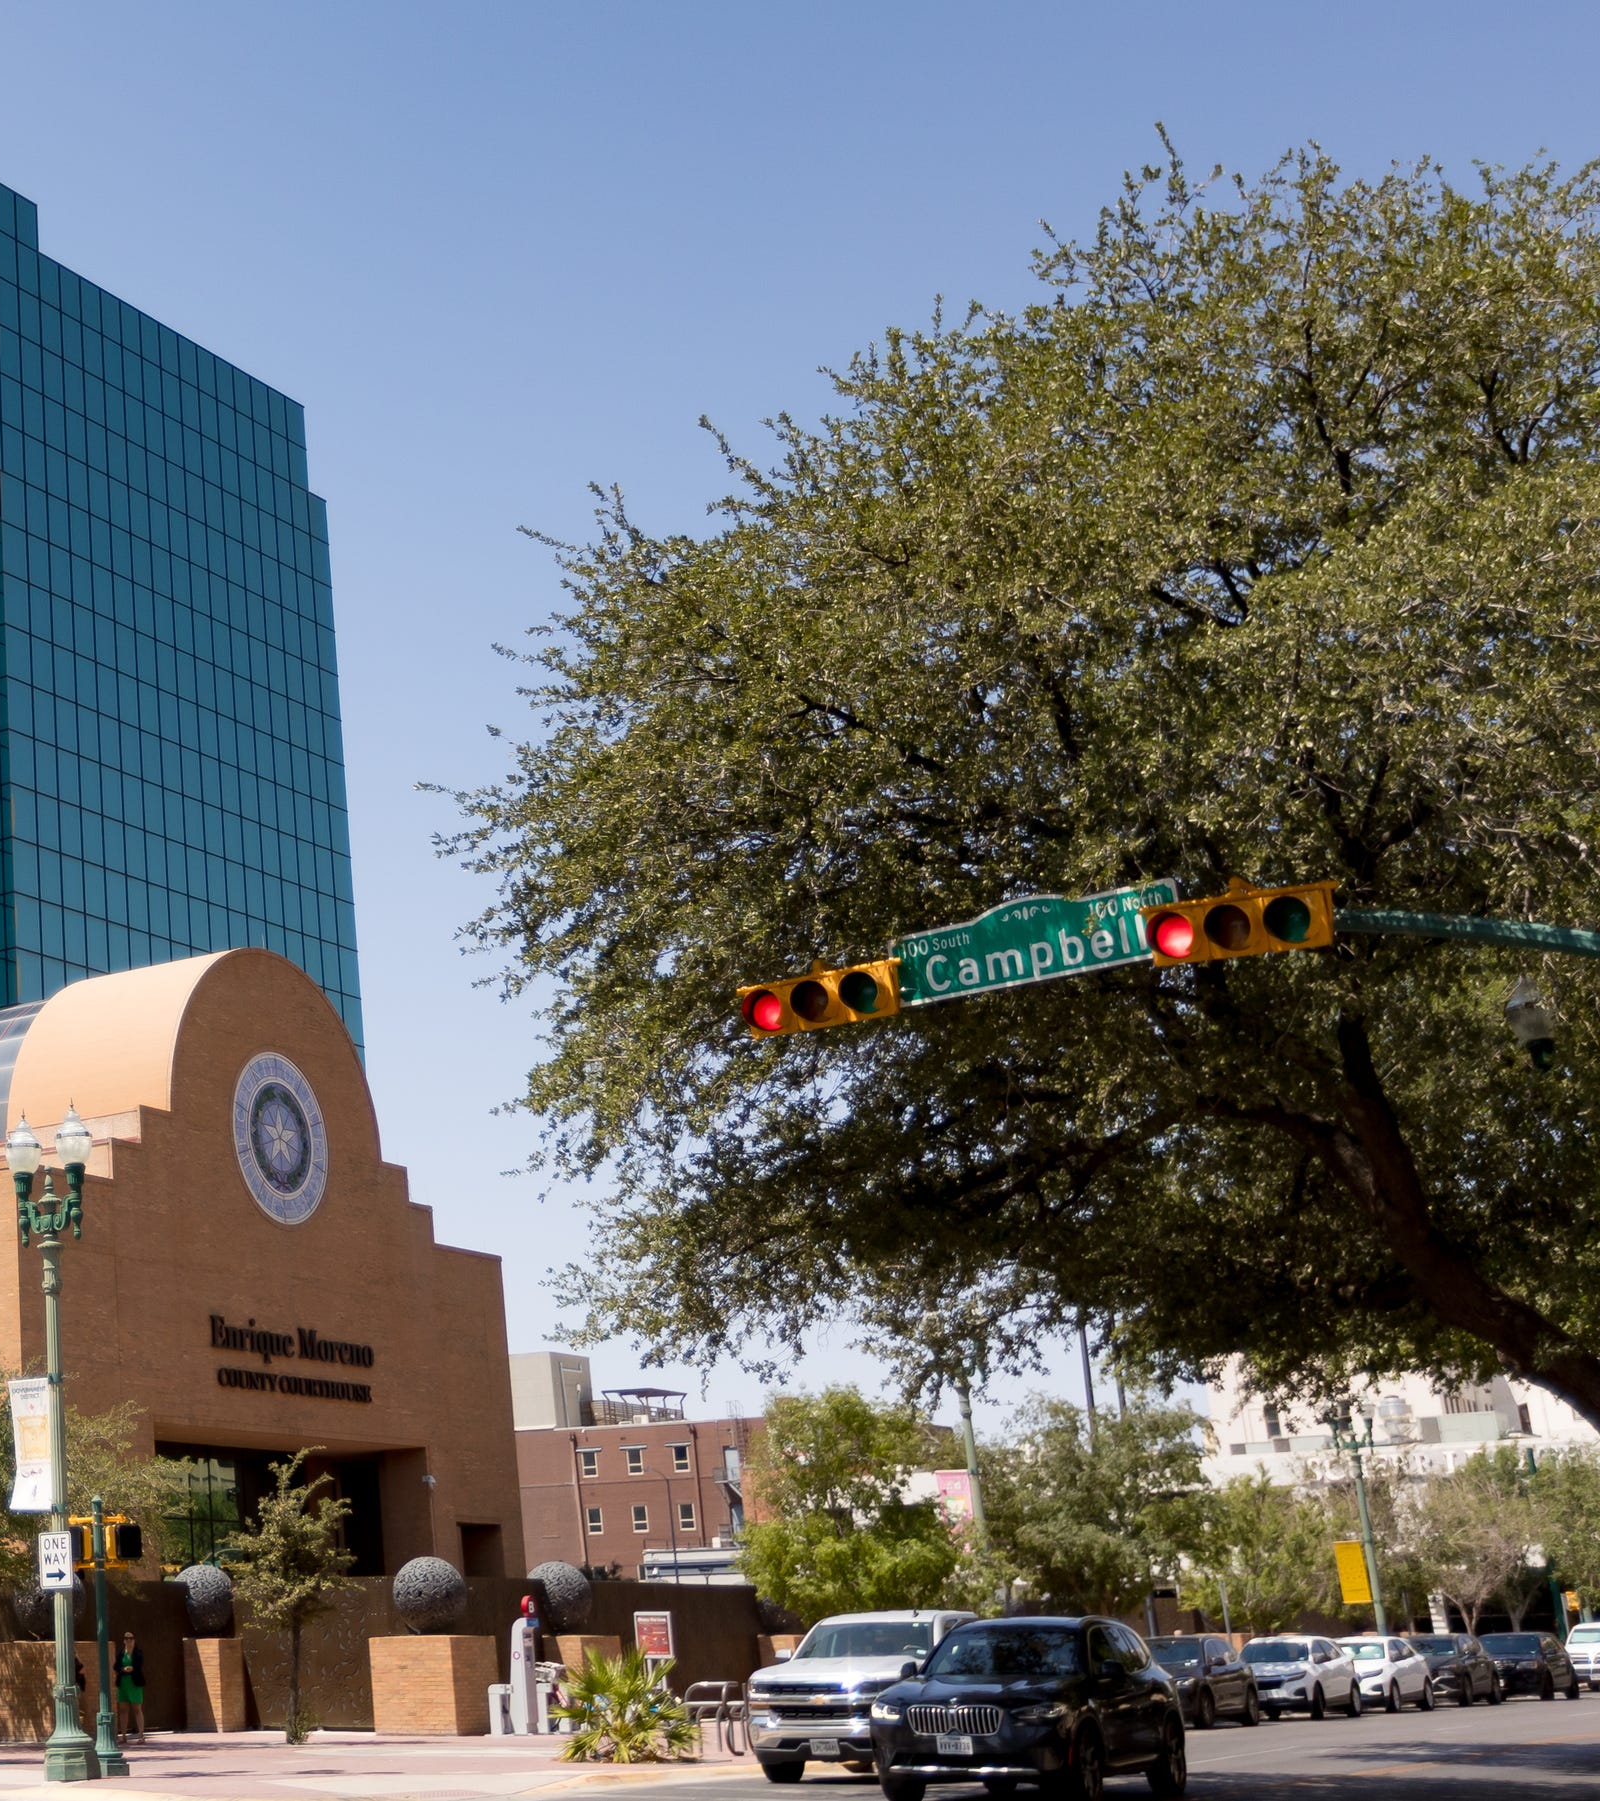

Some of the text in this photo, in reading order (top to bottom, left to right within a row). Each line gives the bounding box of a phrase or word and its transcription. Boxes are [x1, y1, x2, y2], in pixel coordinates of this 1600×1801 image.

[1087, 891, 1163, 919] 100 North
[902, 932, 970, 959] 100 South
[926, 913, 1148, 991] Campbell
[209, 1314, 374, 1368] Enrique Moreno
[217, 1367, 372, 1403] COUNTY COURTHOUSE
[44, 1537, 67, 1550] ONE
[44, 1552, 67, 1565] WAY
